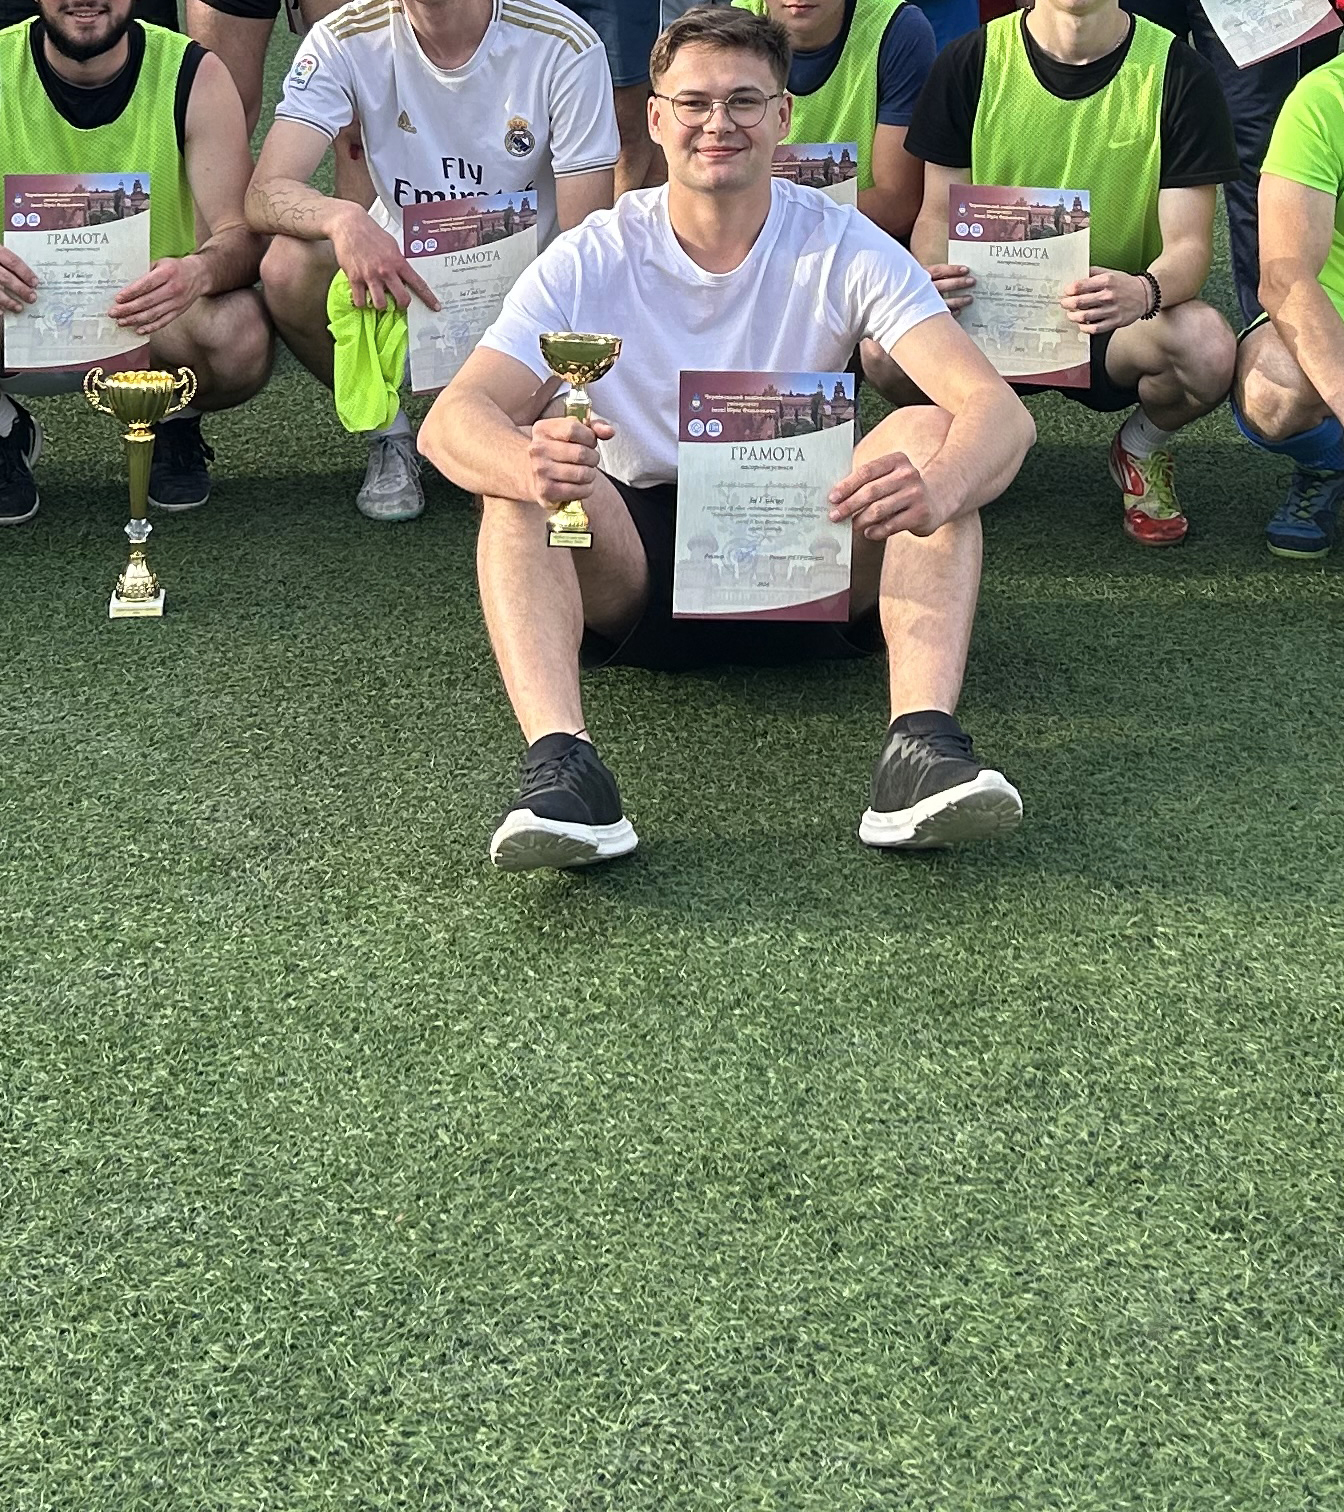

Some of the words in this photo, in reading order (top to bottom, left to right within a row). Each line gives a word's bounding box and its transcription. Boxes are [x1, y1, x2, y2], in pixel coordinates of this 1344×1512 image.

[441, 157, 483, 185] Fly
[47, 233, 109, 245] ГРАМОТА
[444, 250, 501, 267] ГРАМОТА
[989, 245, 1049, 259] ГРАМОТА
[731, 447, 805, 461] ГРАМОТА
